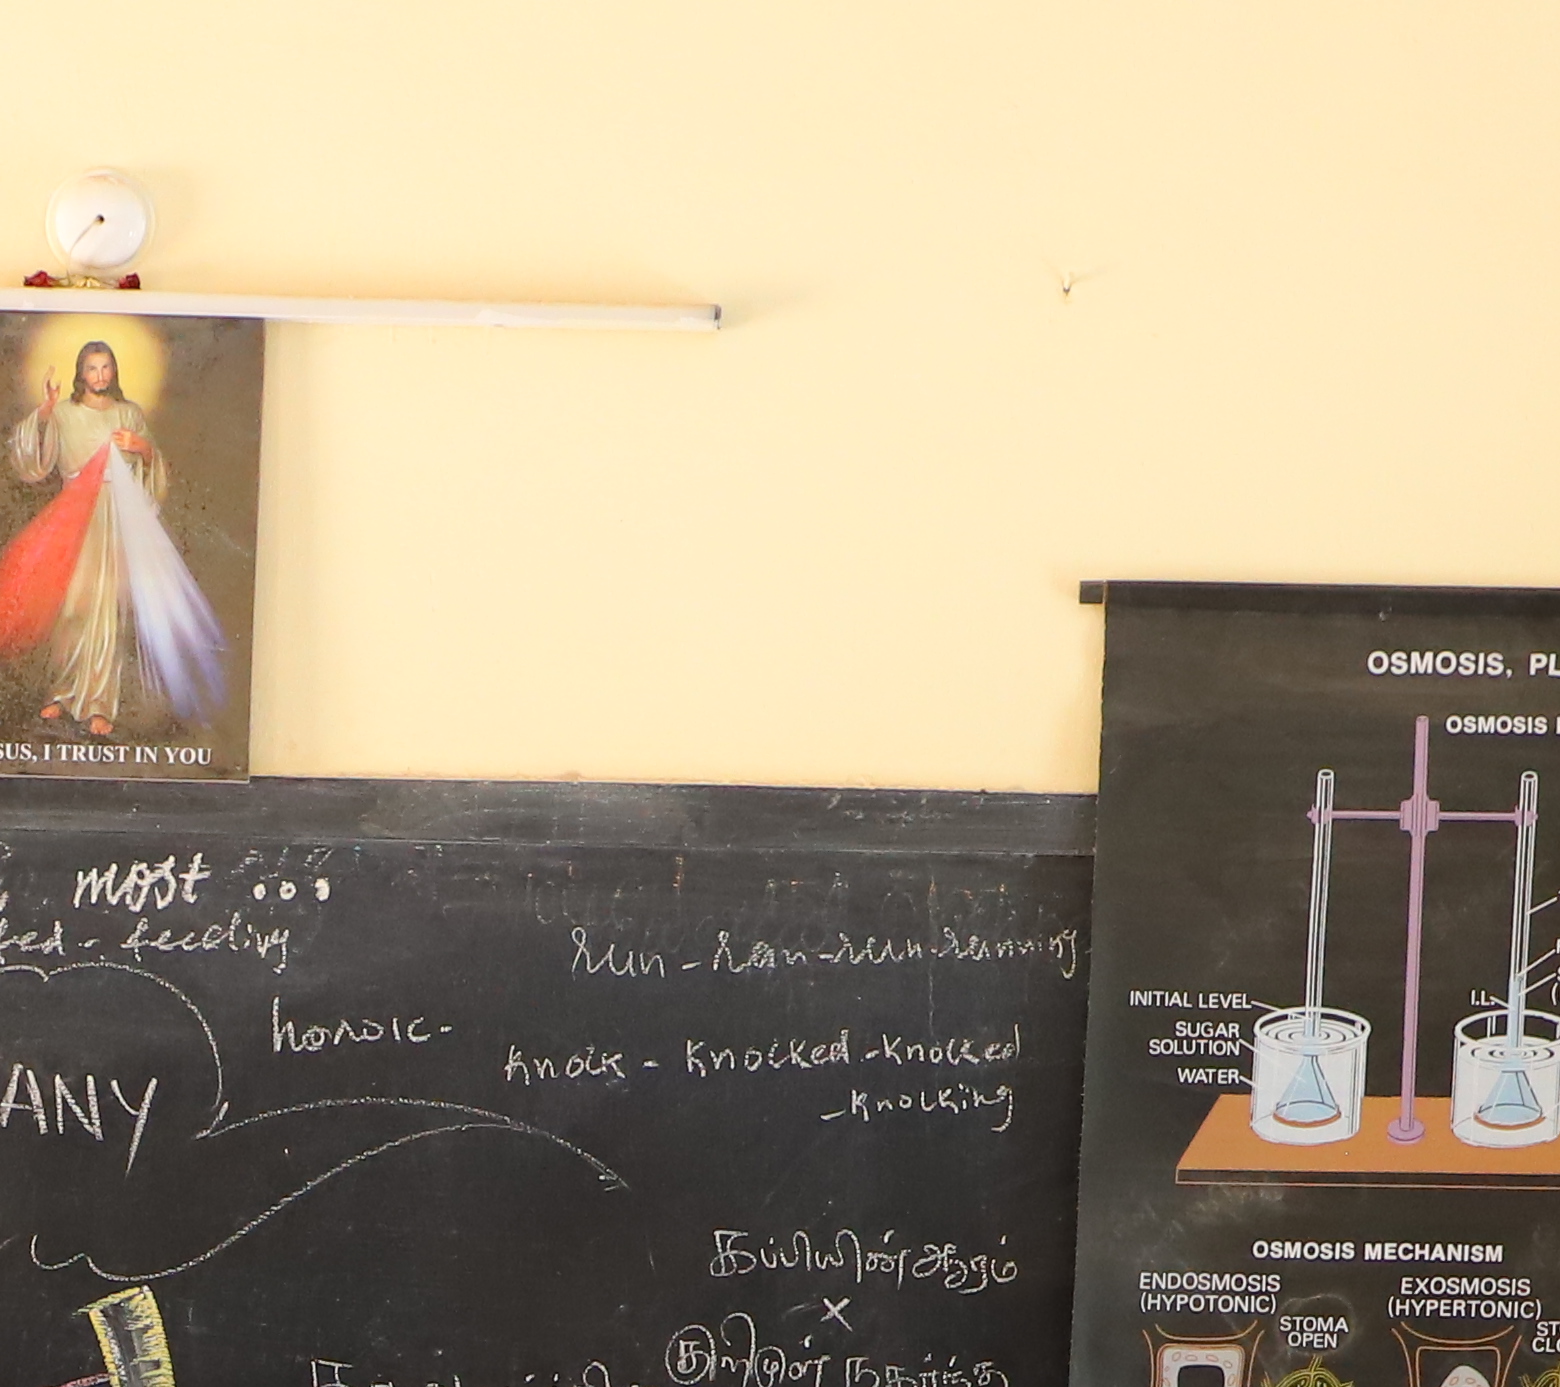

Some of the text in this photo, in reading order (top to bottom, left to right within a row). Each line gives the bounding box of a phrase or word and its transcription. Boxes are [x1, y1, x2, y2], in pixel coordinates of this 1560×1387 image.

[1366, 650, 1513, 679] OSMOSIS,
[1446, 715, 1549, 735] OSMOSIS
[44, 744, 51, 760] I
[56, 744, 130, 762] TRUST
[135, 746, 158, 764] IN
[164, 747, 212, 766] YOU
[73, 853, 212, 912] most
[1129, 990, 1252, 1009] INITIAL LEVEL
[1175, 1021, 1240, 1039] SUGAR
[1148, 1039, 1240, 1056] SOLUTION
[1177, 1067, 1240, 1085] WATER
[1252, 1241, 1504, 1263] OSMOSIS MECHANISM
[1139, 1273, 1281, 1292] ENDOSMOSIS
[1400, 1277, 1532, 1296] EXOSMOSIS
[1139, 1293, 1277, 1315] (HYPOTONIC)
[1386, 1296, 1542, 1321] (HYPERTONIC)
[1279, 1315, 1349, 1333] STOMA
[1287, 1331, 1338, 1349] OPEN
